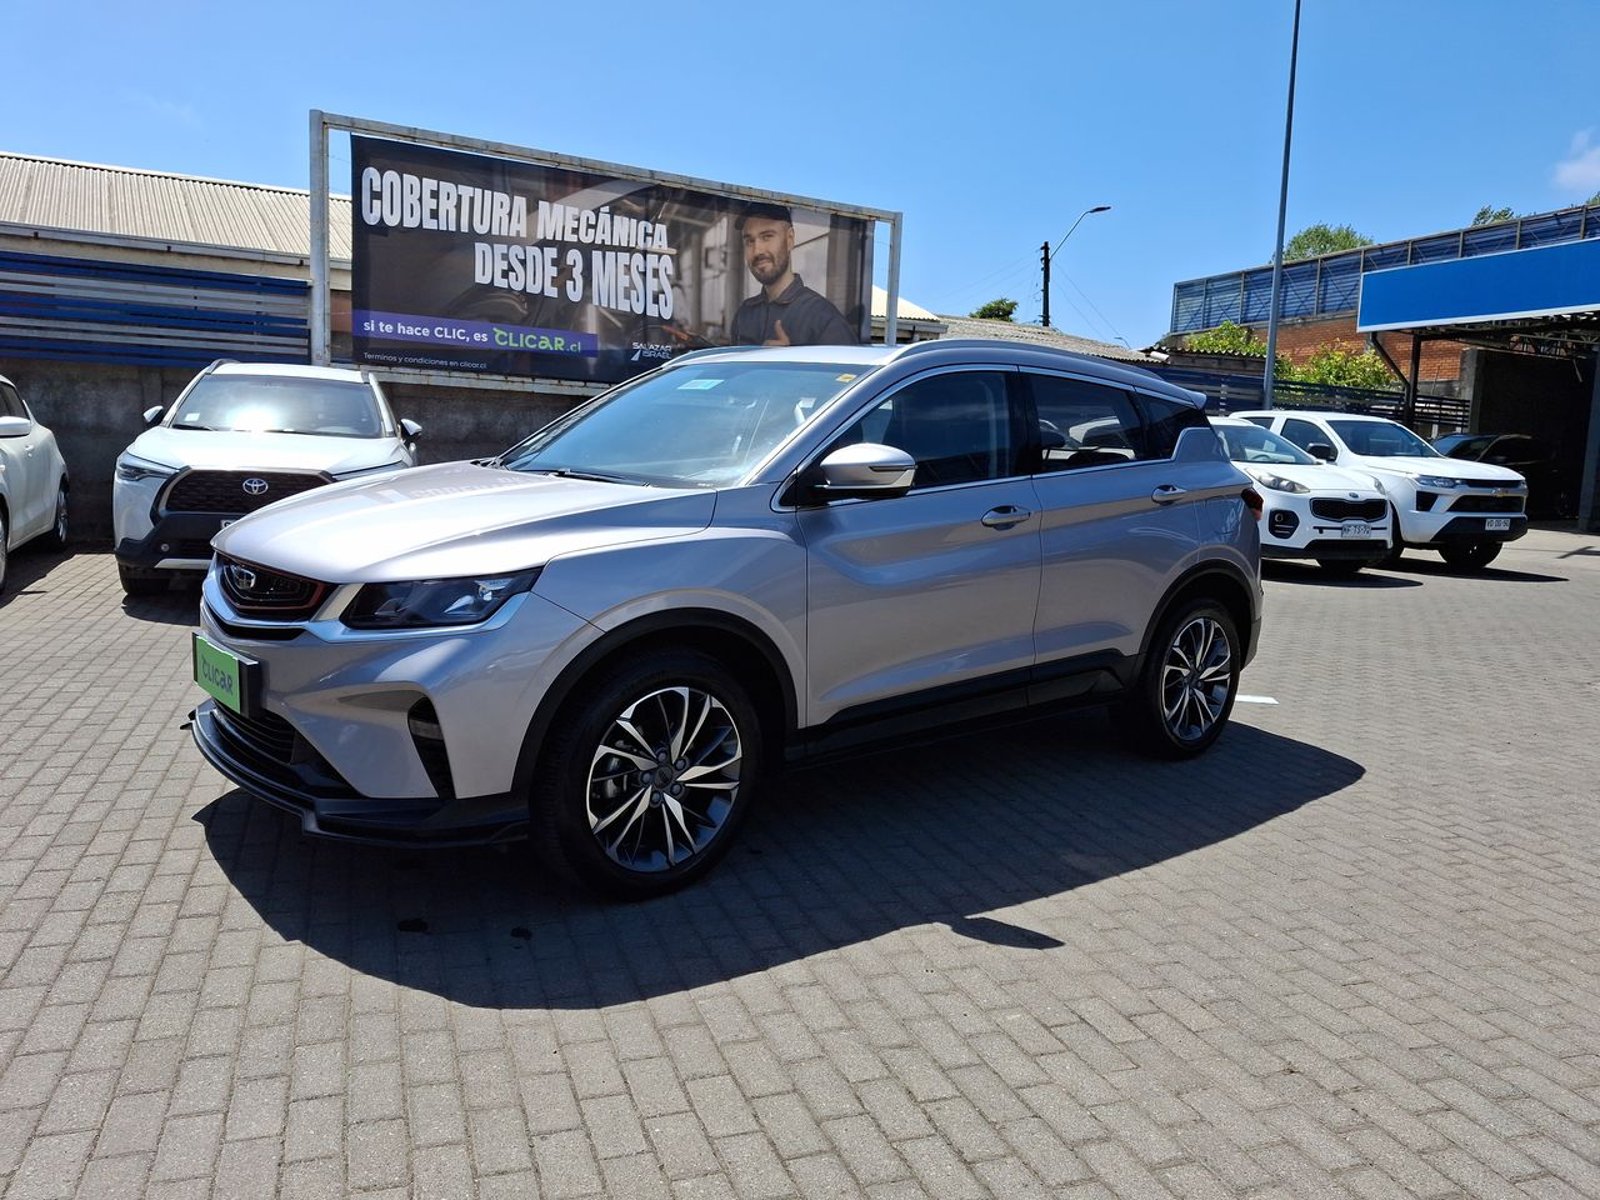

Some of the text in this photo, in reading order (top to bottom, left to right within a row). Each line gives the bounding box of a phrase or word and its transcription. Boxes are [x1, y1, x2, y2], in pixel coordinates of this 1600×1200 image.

[362, 166, 669, 249] COBERTURA MECÁNICA
[475, 242, 674, 320] DESDE 3 MESES
[363, 320, 375, 332] si
[378, 321, 393, 333] te
[397, 322, 430, 336] hace
[434, 327, 470, 342] CLIC,
[473, 332, 488, 342] es
[632, 341, 672, 352] SALAZAR
[404, 356, 448, 366] condiciones
